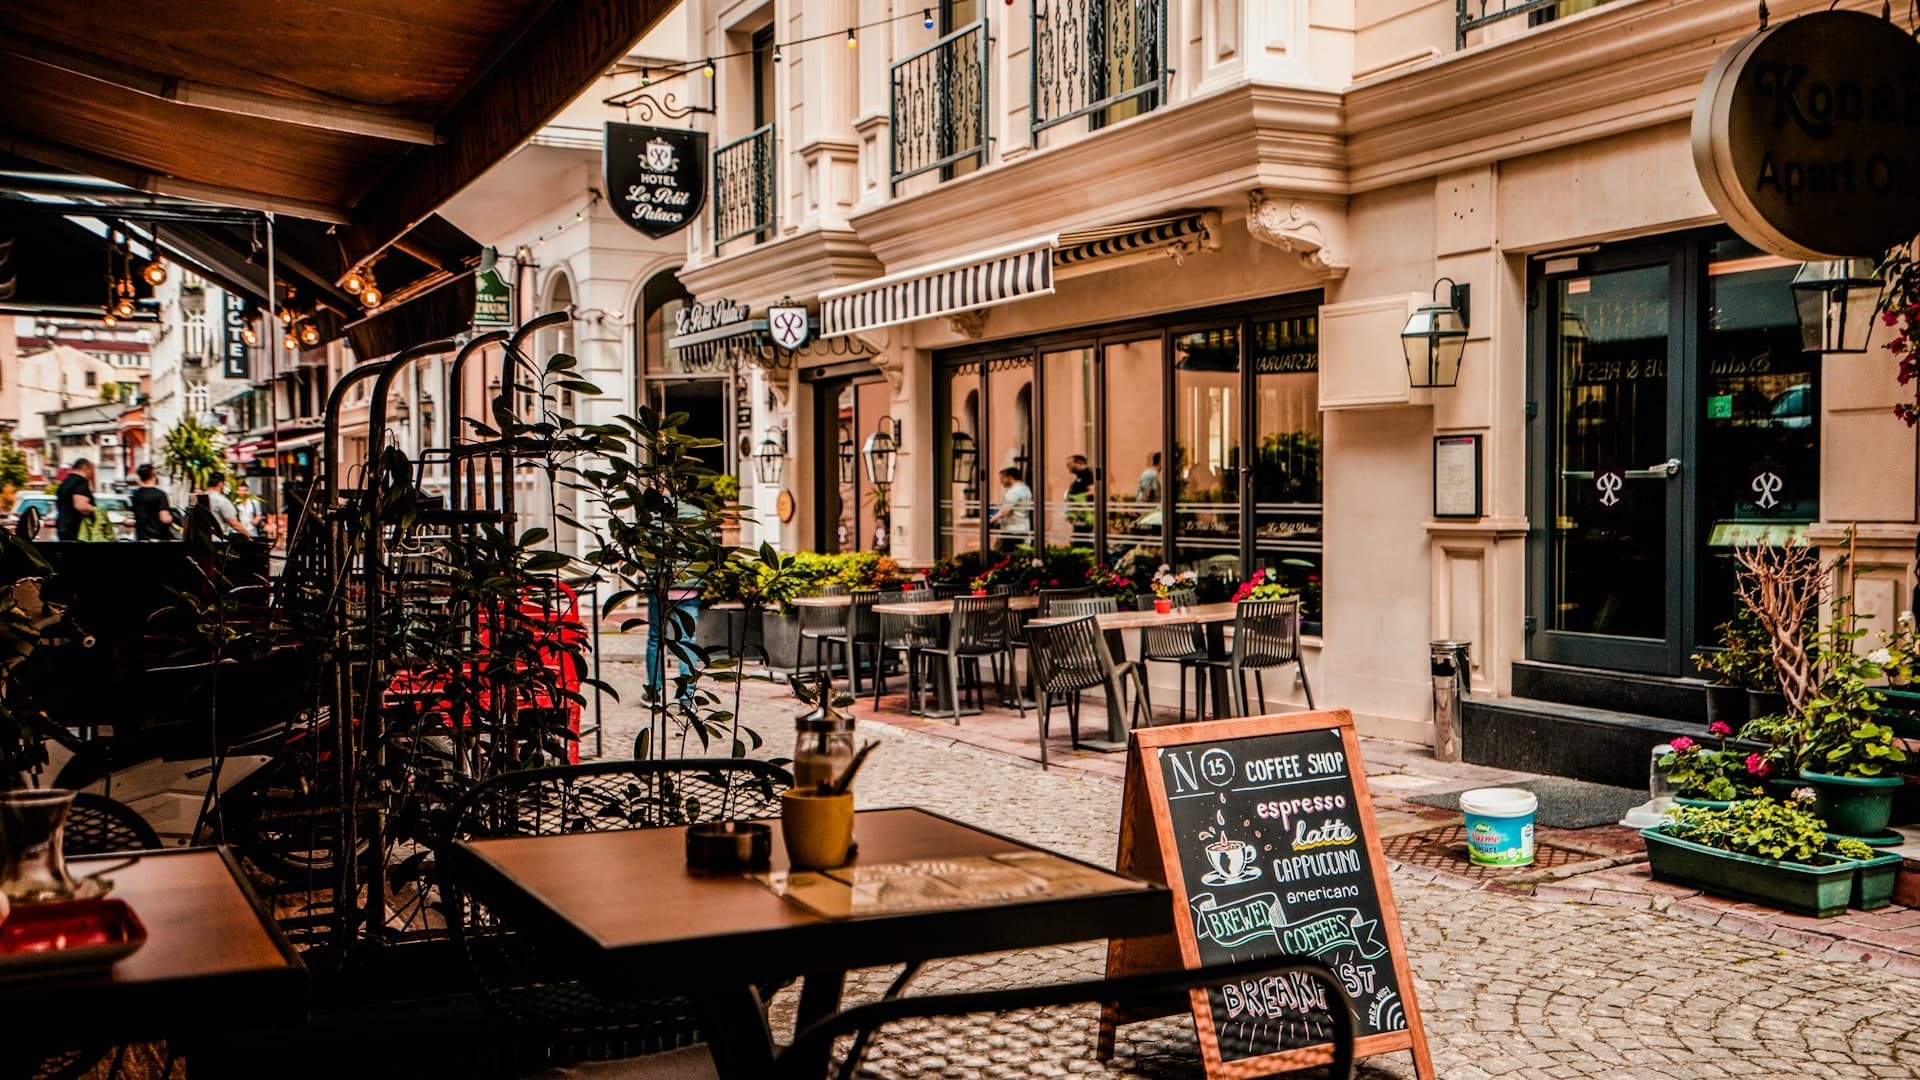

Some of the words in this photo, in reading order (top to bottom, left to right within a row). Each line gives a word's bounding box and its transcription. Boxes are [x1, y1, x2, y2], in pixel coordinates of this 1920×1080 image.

[640, 173, 678, 187] HOTEL
[1756, 151, 1858, 204] Apart
[625, 185, 651, 202] Le
[651, 187, 691, 206] Petit
[631, 202, 684, 223] Palace
[674, 307, 690, 336] Le
[1168, 751, 1199, 793] N
[1207, 758, 1227, 777] 15
[1245, 754, 1303, 783] COFFEE
[1307, 751, 1345, 775] SHOP
[1256, 794, 1347, 832] espresso
[1291, 819, 1358, 848] latte
[1273, 849, 1361, 882] CAPPUCCINO
[1286, 884, 1359, 905] americano
[1207, 900, 1273, 939] BREWED
[1283, 913, 1352, 955] COFFEES
[1368, 1001, 1378, 1027] FREE
